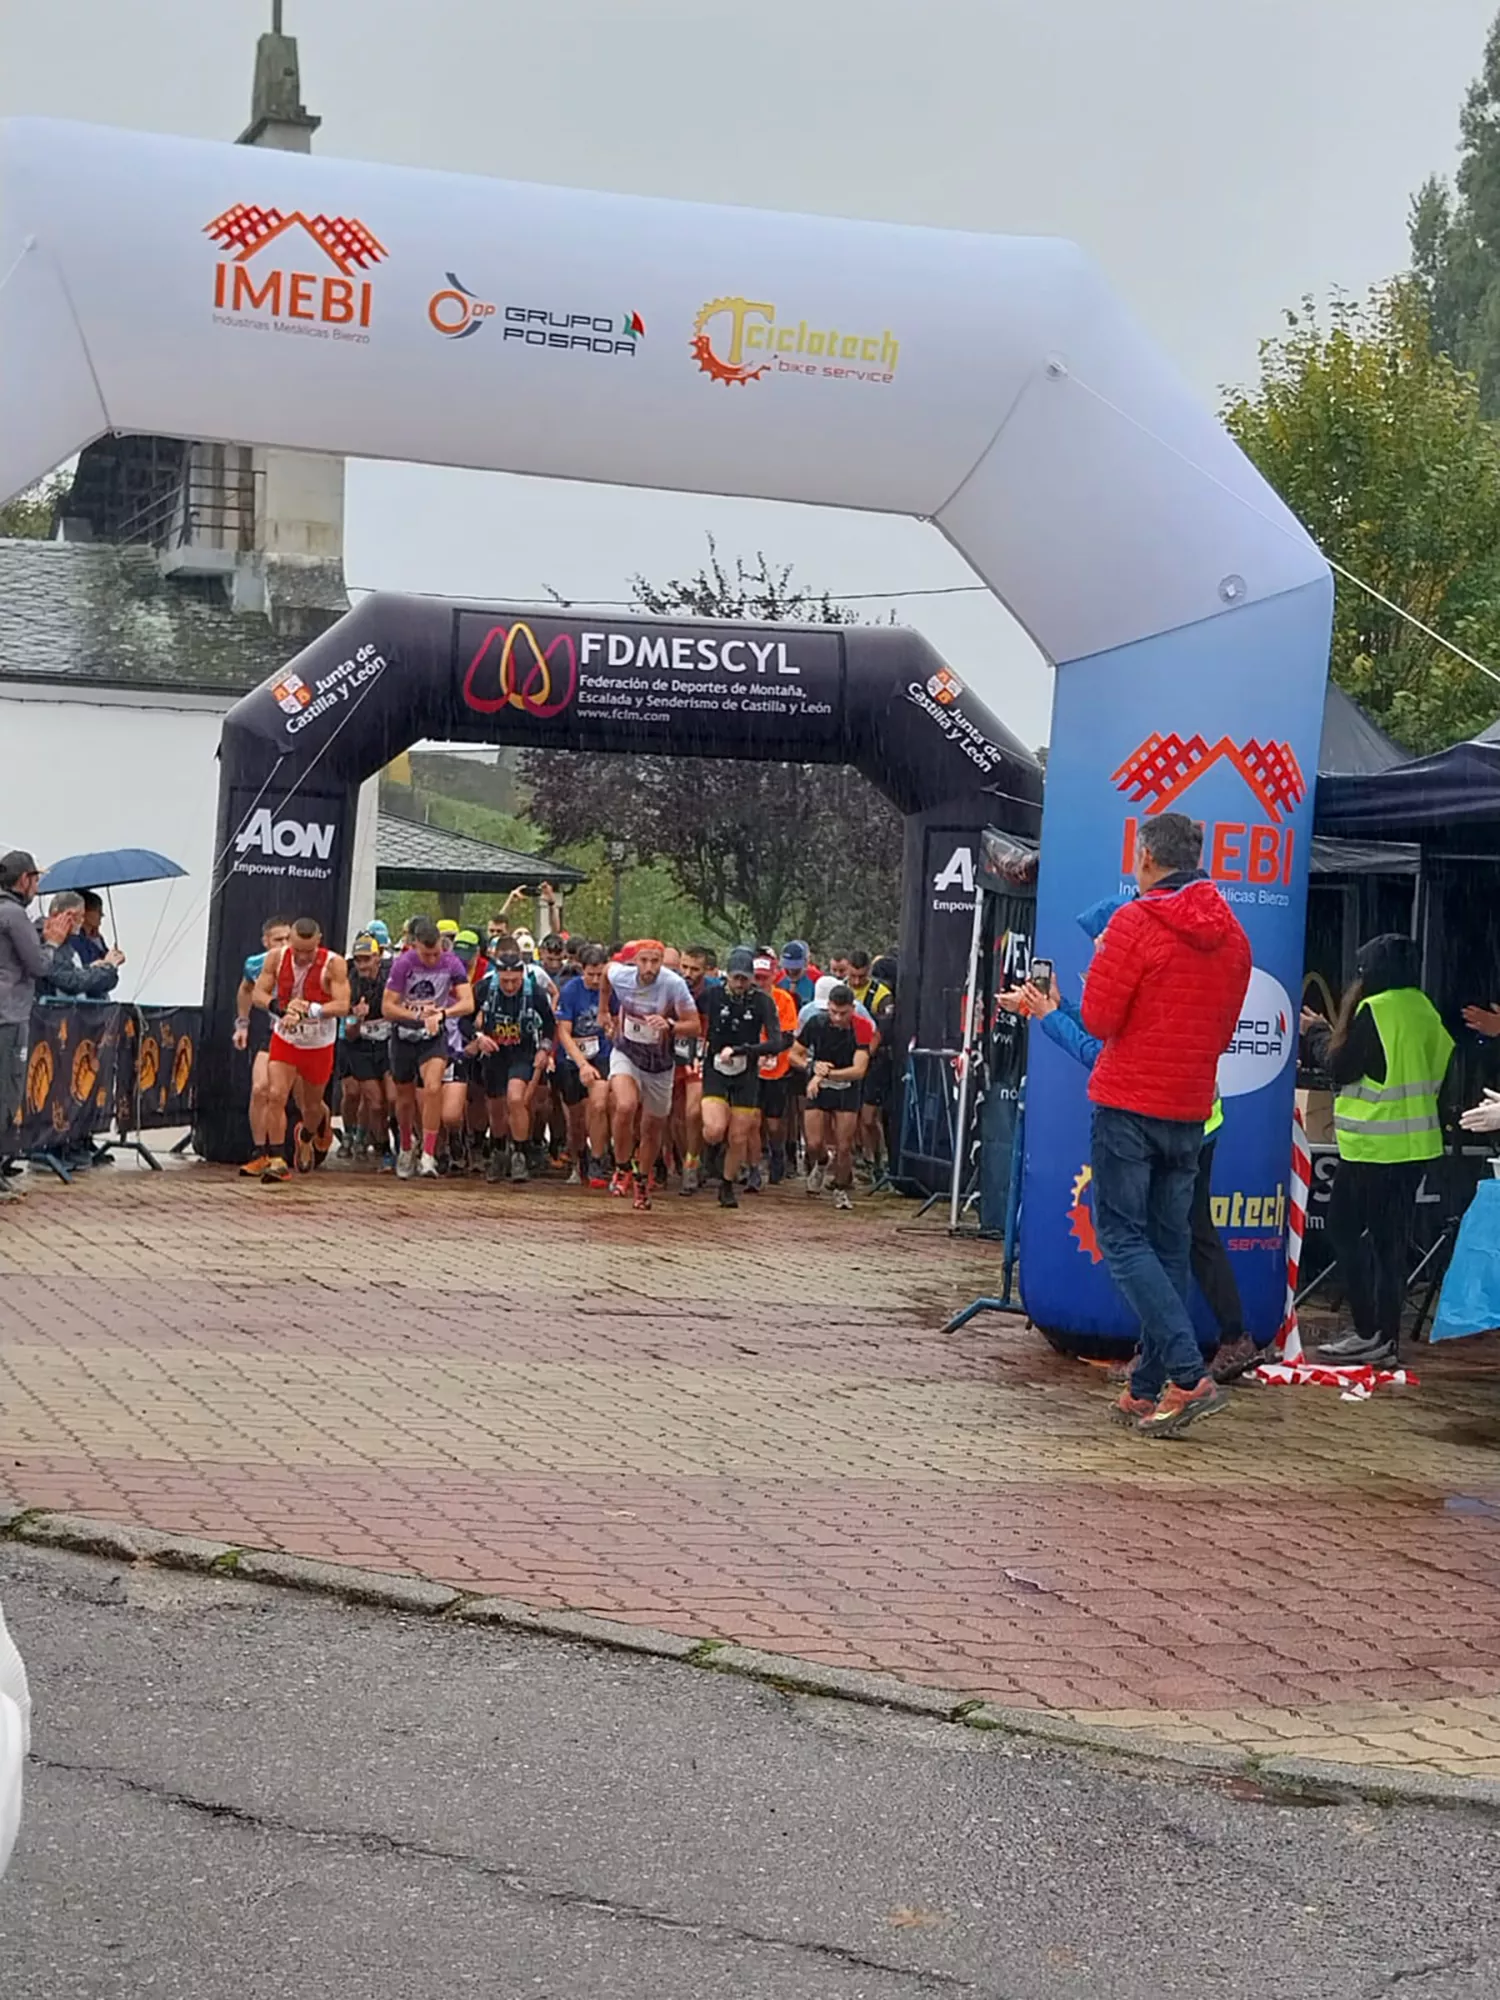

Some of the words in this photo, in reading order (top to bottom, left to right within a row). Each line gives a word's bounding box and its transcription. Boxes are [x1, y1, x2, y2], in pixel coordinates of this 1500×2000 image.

[213, 262, 373, 328] IMEBI
[212, 313, 270, 331] Industrias
[332, 328, 370, 344] Bierzo
[505, 306, 613, 333] GRUPO
[503, 327, 636, 357] POSADA
[778, 360, 817, 376] bike
[822, 366, 894, 384] service
[580, 632, 801, 675] FDMESCYL
[315, 660, 356, 695] Junta
[356, 643, 376, 663] de
[285, 692, 338, 734] Castilla
[336, 683, 349, 700] y
[347, 656, 387, 688] León
[579, 674, 649, 690] Federación
[652, 679, 669, 691] de
[671, 680, 728, 695] Deportes
[730, 683, 747, 695] de
[749, 683, 807, 699] Montaña,
[576, 708, 670, 722] www.fclm.com
[578, 691, 633, 706] Escalada
[635, 697, 644, 708] y
[646, 694, 719, 709] Senderismo
[721, 698, 738, 711] de
[741, 699, 786, 713] Castilla
[789, 703, 798, 715] y
[800, 701, 832, 714] León
[908, 682, 952, 730] Castilla
[945, 728, 962, 740] y
[959, 737, 993, 773] León
[948, 708, 984, 745] Junta
[983, 744, 1002, 764] de
[1121, 816, 1295, 887] IEBI
[233, 860, 286, 876] Empower
[933, 899, 977, 914] Empow
[1224, 1040, 1282, 1056] SADA
